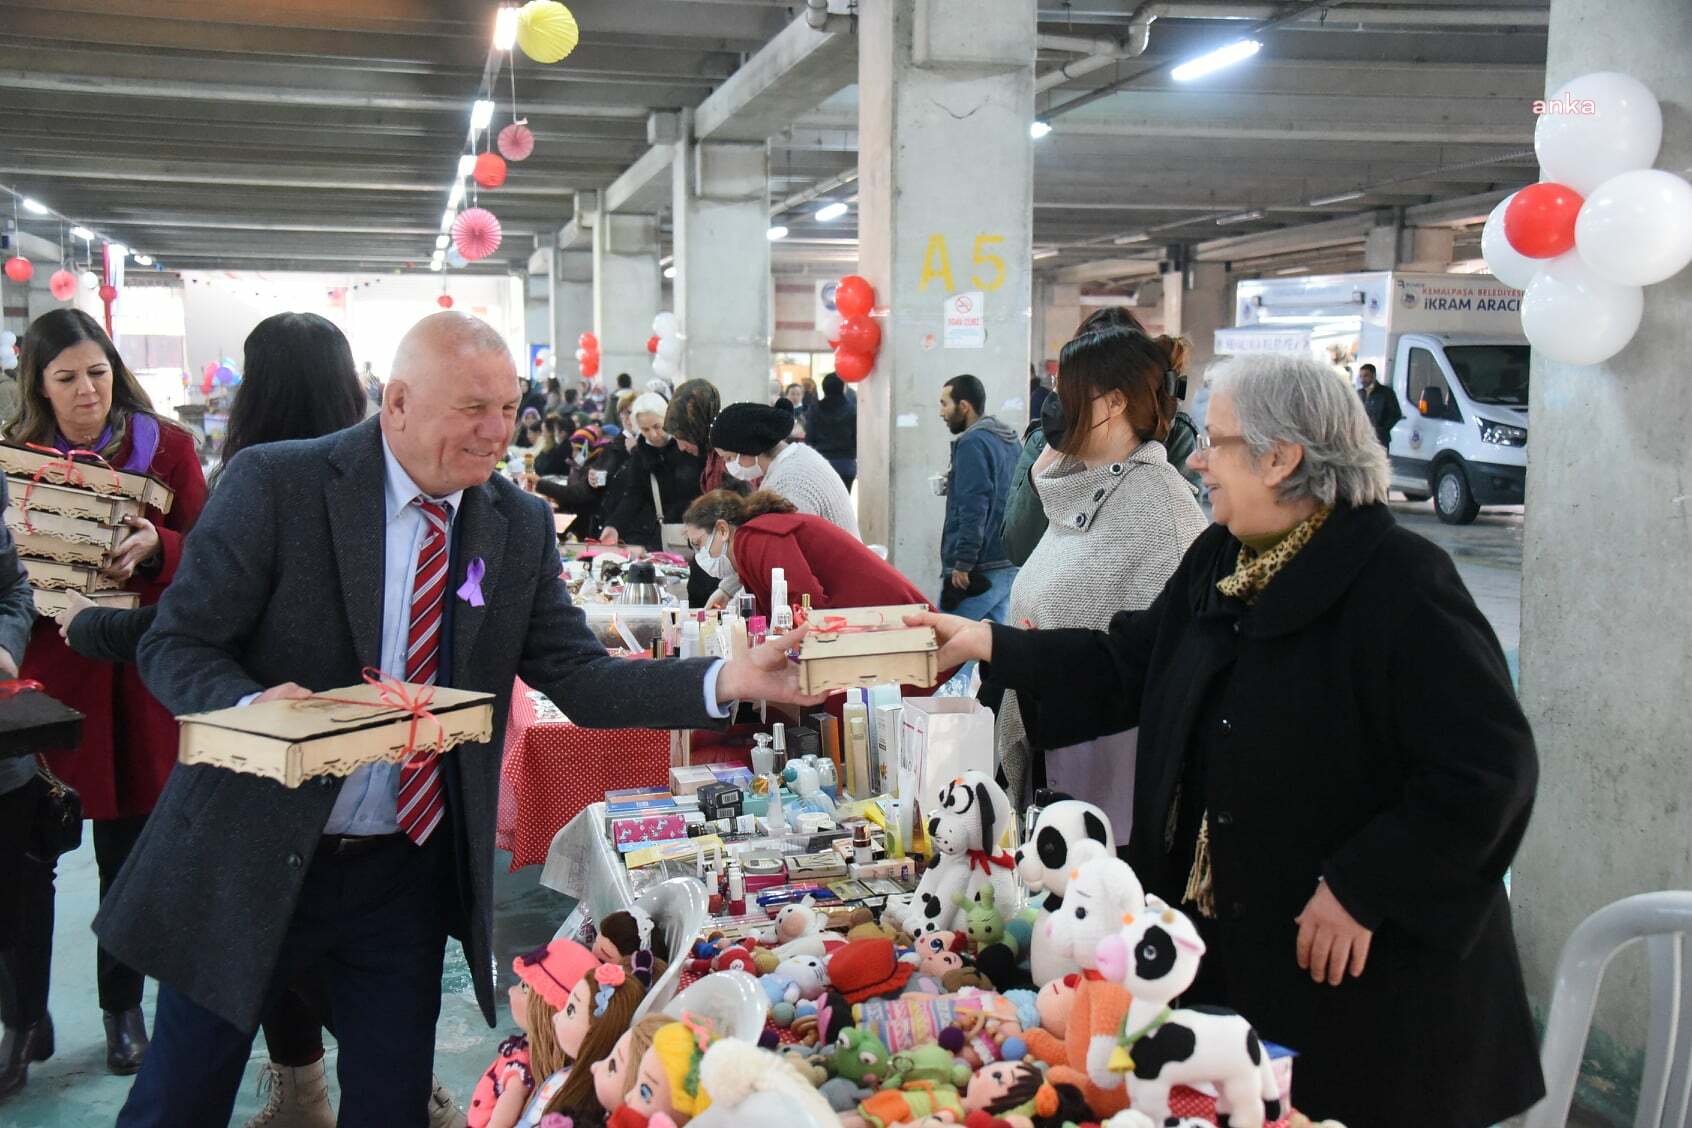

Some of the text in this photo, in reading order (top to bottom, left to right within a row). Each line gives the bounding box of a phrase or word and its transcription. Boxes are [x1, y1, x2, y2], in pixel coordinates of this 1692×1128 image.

[917, 232, 1007, 292] A 5
[1477, 298, 1520, 312] ARACI
